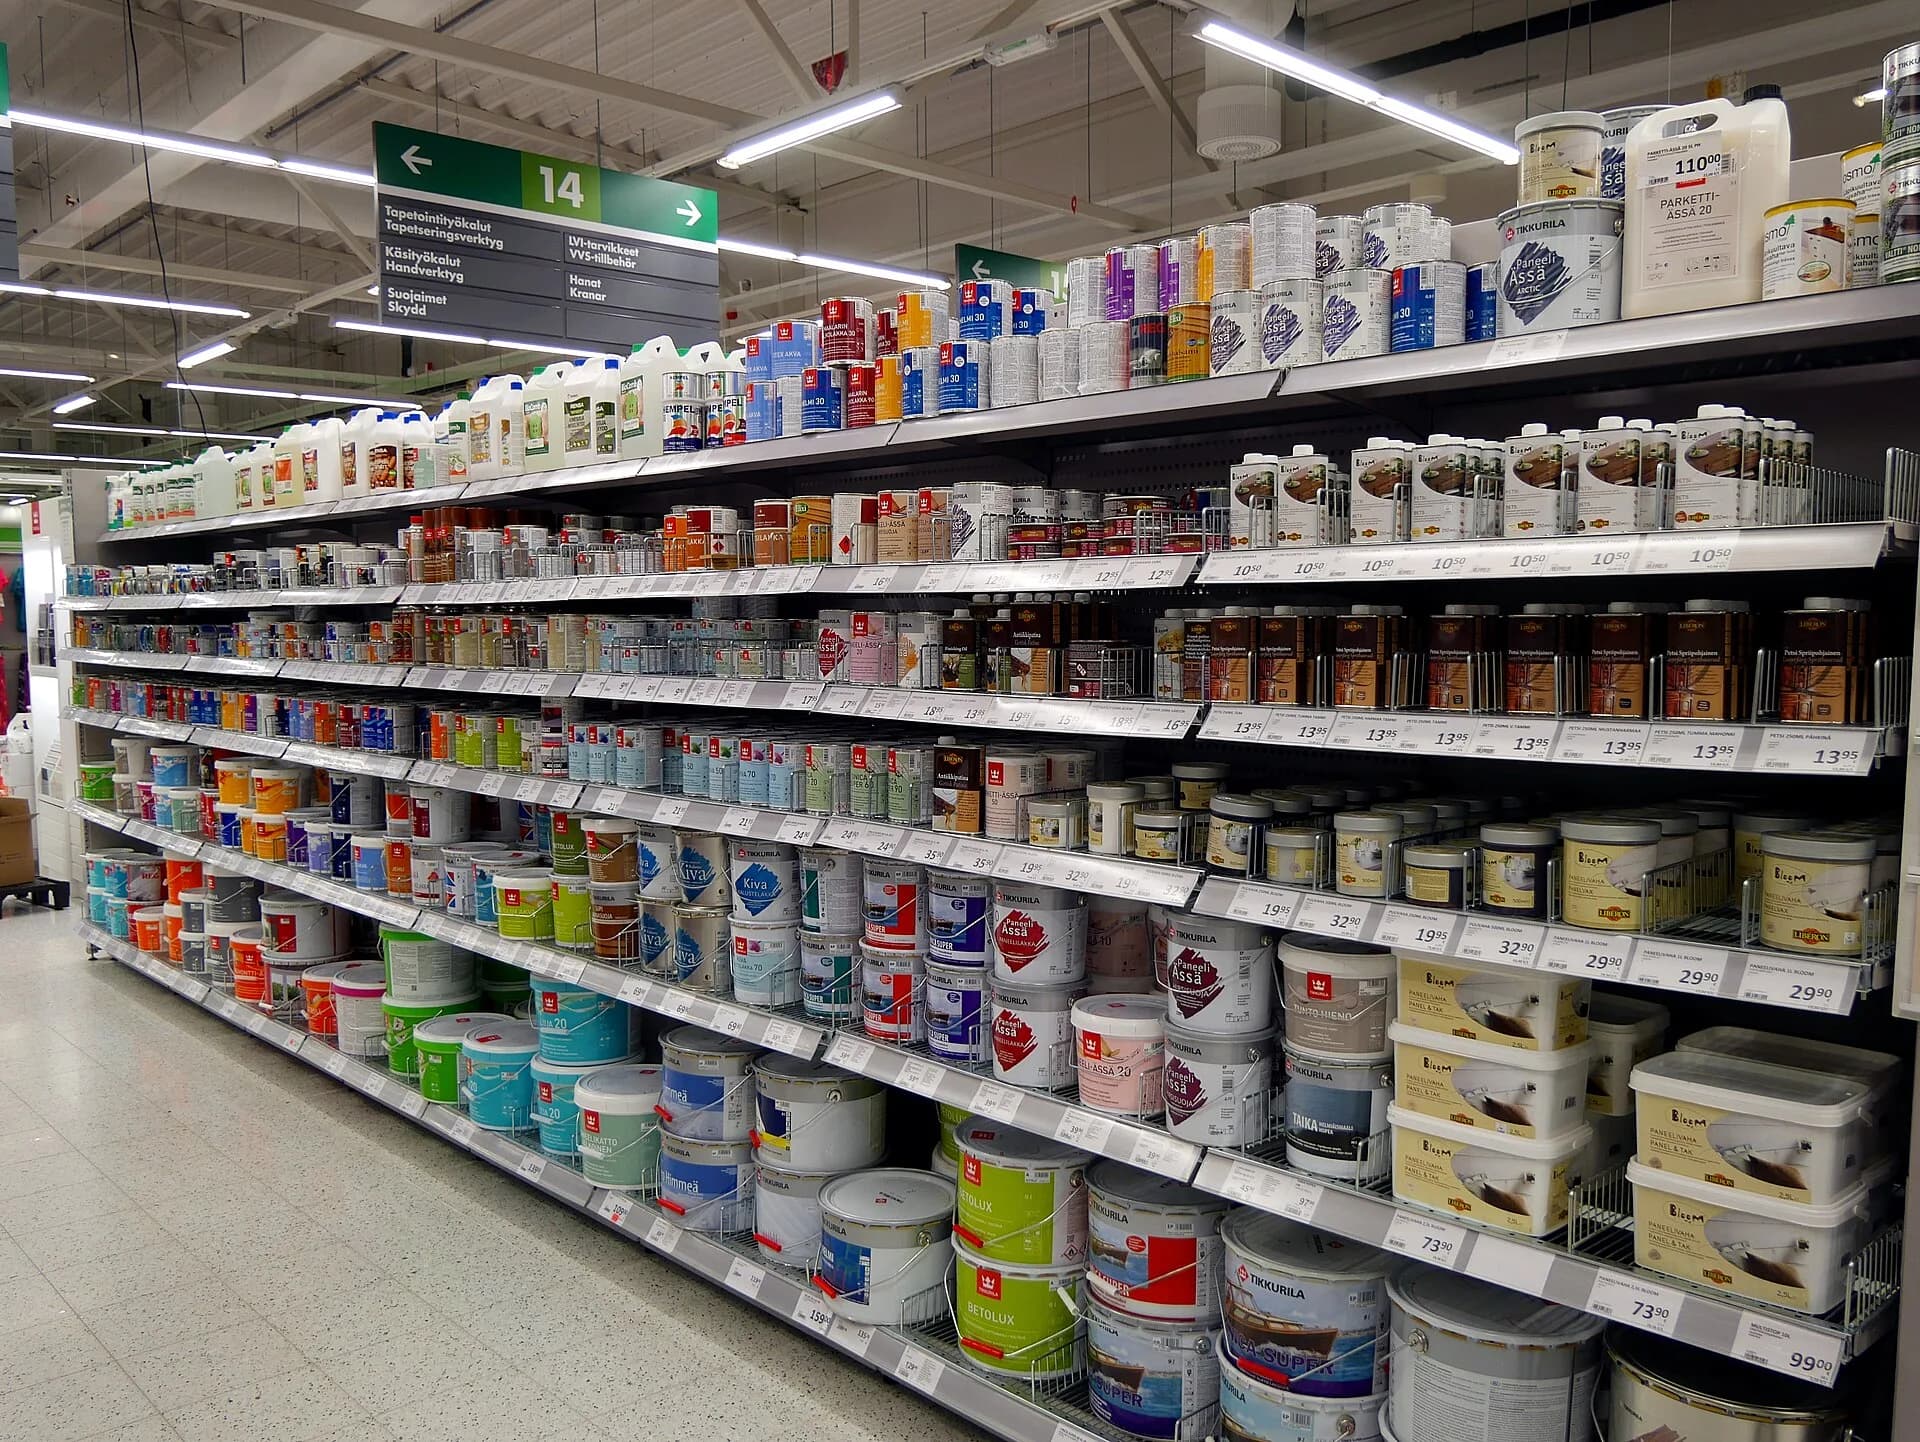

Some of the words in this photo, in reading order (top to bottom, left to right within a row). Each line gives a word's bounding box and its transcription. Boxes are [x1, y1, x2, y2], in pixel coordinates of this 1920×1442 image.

[539, 166, 584, 208] 14
[1660, 192, 1721, 209] PARKETTI-
[385, 205, 491, 232] Tapetointityökalut
[1666, 205, 1696, 220] ÄSSÄ
[1699, 204, 1712, 215] 20
[385, 219, 504, 250] Tapetseringsverktyg
[1516, 219, 1566, 235] TIKKURILA
[569, 236, 639, 257] LVI-tarvikkeet
[385, 246, 461, 268] Käsityökalut
[569, 250, 636, 269] VVS-tillbehör
[1517, 252, 1556, 269] Paneeli
[385, 260, 464, 283] Handverktyg
[1510, 266, 1545, 287] Ässä
[570, 275, 601, 289] Hanat
[387, 288, 447, 305] Suojaimet
[570, 288, 607, 302] Kranar
[388, 300, 426, 316] Skydd
[975, 313, 985, 321] 30
[1018, 321, 1028, 329] 30
[816, 397, 825, 405] 30
[743, 877, 767, 890] Kiva
[1262, 902, 1290, 917] 1995
[1329, 914, 1361, 929] 3290
[1176, 930, 1217, 944] TIKKURILA
[1415, 928, 1448, 943] 1995
[1793, 930, 1830, 943] LIBERON
[1498, 941, 1535, 956] 3290
[1177, 959, 1210, 973] Paneeli
[1585, 955, 1623, 970] 2990
[1172, 962, 1202, 985] Ässä
[1679, 970, 1718, 986] 2990
[1789, 985, 1833, 1001] 2990
[554, 1018, 567, 1029] 20
[550, 1107, 560, 1119] 20
[1292, 1111, 1318, 1132] TAIKA
[665, 1171, 699, 1194] Himmeä
[1422, 1236, 1453, 1252] 7390
[1249, 1274, 1306, 1300] TIKKURILA
[968, 1301, 1014, 1326] BETOLUX
[1632, 1301, 1669, 1320] 7390
[1789, 1353, 1833, 1372] 9900
